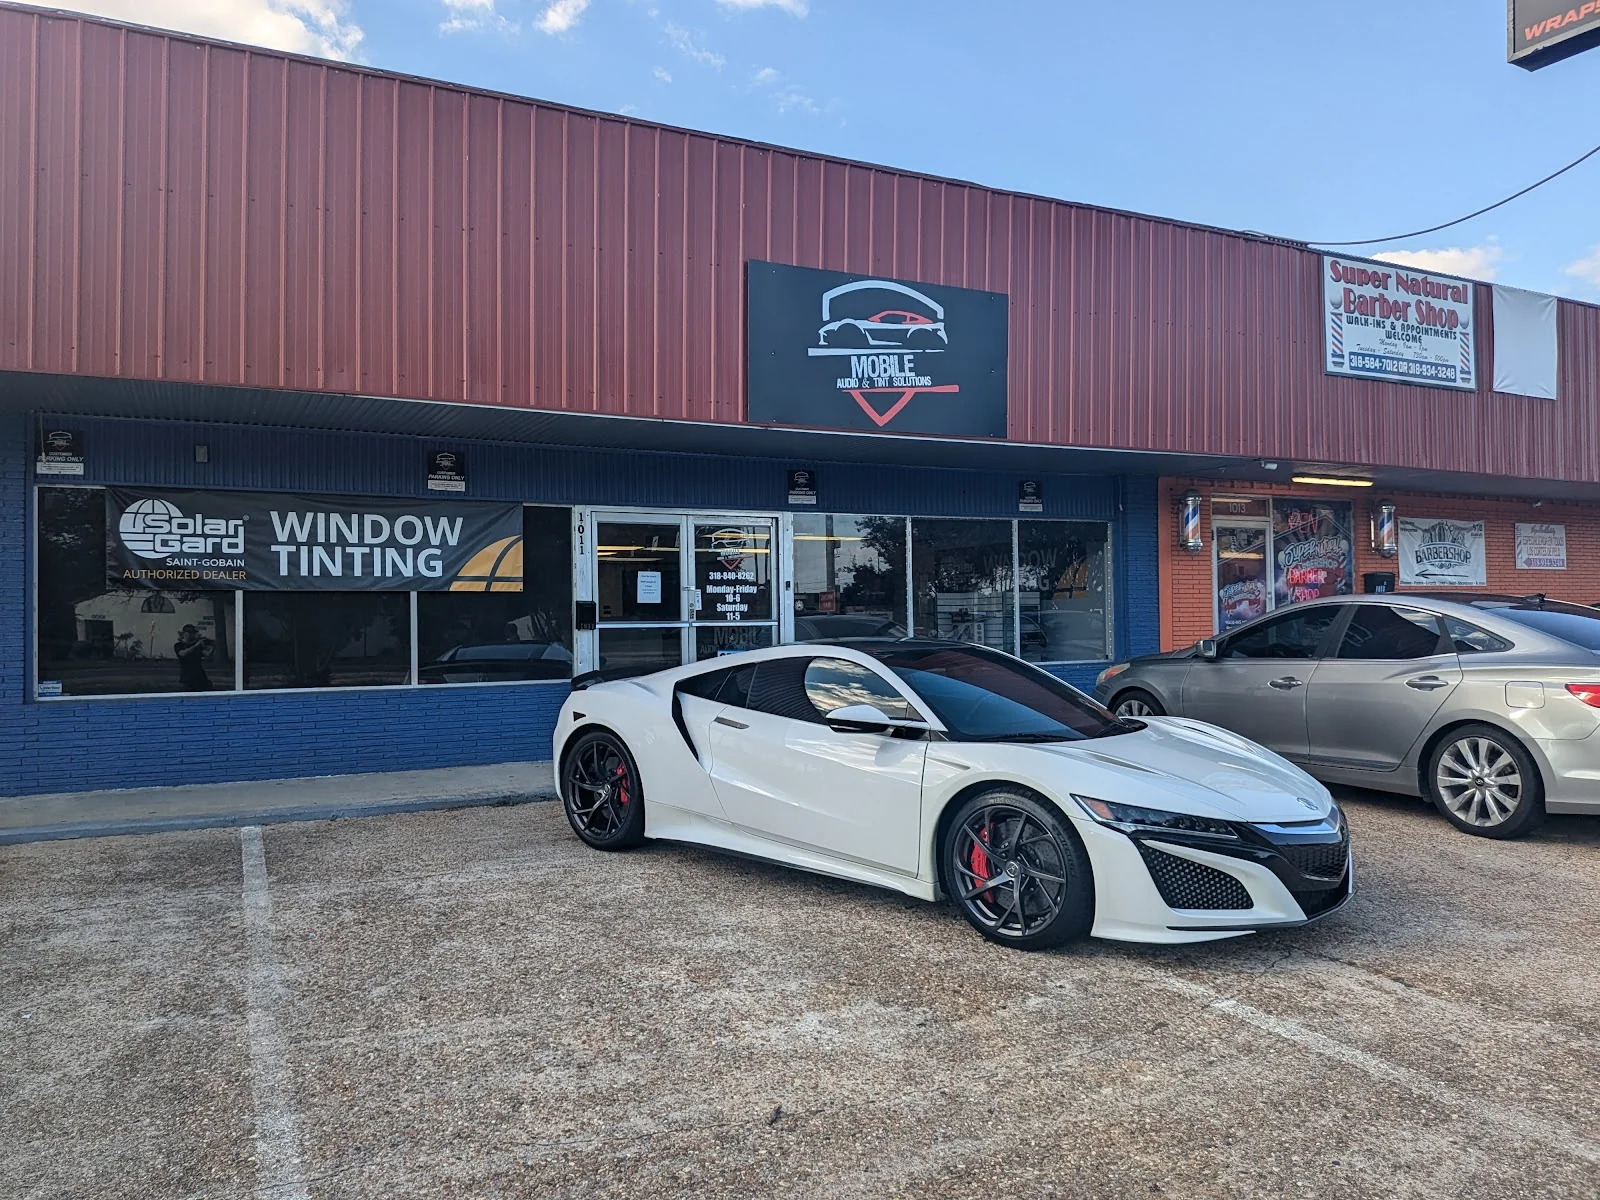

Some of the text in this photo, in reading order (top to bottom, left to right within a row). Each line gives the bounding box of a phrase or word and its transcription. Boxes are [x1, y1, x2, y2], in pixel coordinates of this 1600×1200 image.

[1330, 260, 1468, 304] Super Natural
[1343, 287, 1458, 330] Barber Shop
[1346, 315, 1457, 340] WALK-INS & APPOINTMENTS
[1385, 330, 1422, 343] WELCOME
[850, 355, 915, 378] MOBILE
[1350, 354, 1455, 379] 318-584-7012 OR 318-934-3248
[836, 376, 932, 388] AUDIO & TINT SOLUTIONS
[1229, 503, 1246, 513] 1013
[143, 513, 243, 535] Solar
[270, 511, 464, 546] WINDOW
[154, 526, 244, 554] Gard
[166, 558, 245, 567] SAINT-GOBAIN
[271, 545, 443, 578] TINTING
[1415, 546, 1472, 564] BARBERSHOP
[123, 569, 247, 580] AUTHORIZED DEALER
[709, 572, 754, 580] 318-840-8262
[1289, 568, 1325, 584] BARBER
[706, 584, 757, 594] Monday-Friday
[1296, 588, 1319, 602] SHOP
[725, 594, 741, 602] 10-6
[717, 603, 748, 612] Saturday
[726, 612, 741, 620] 11-5
